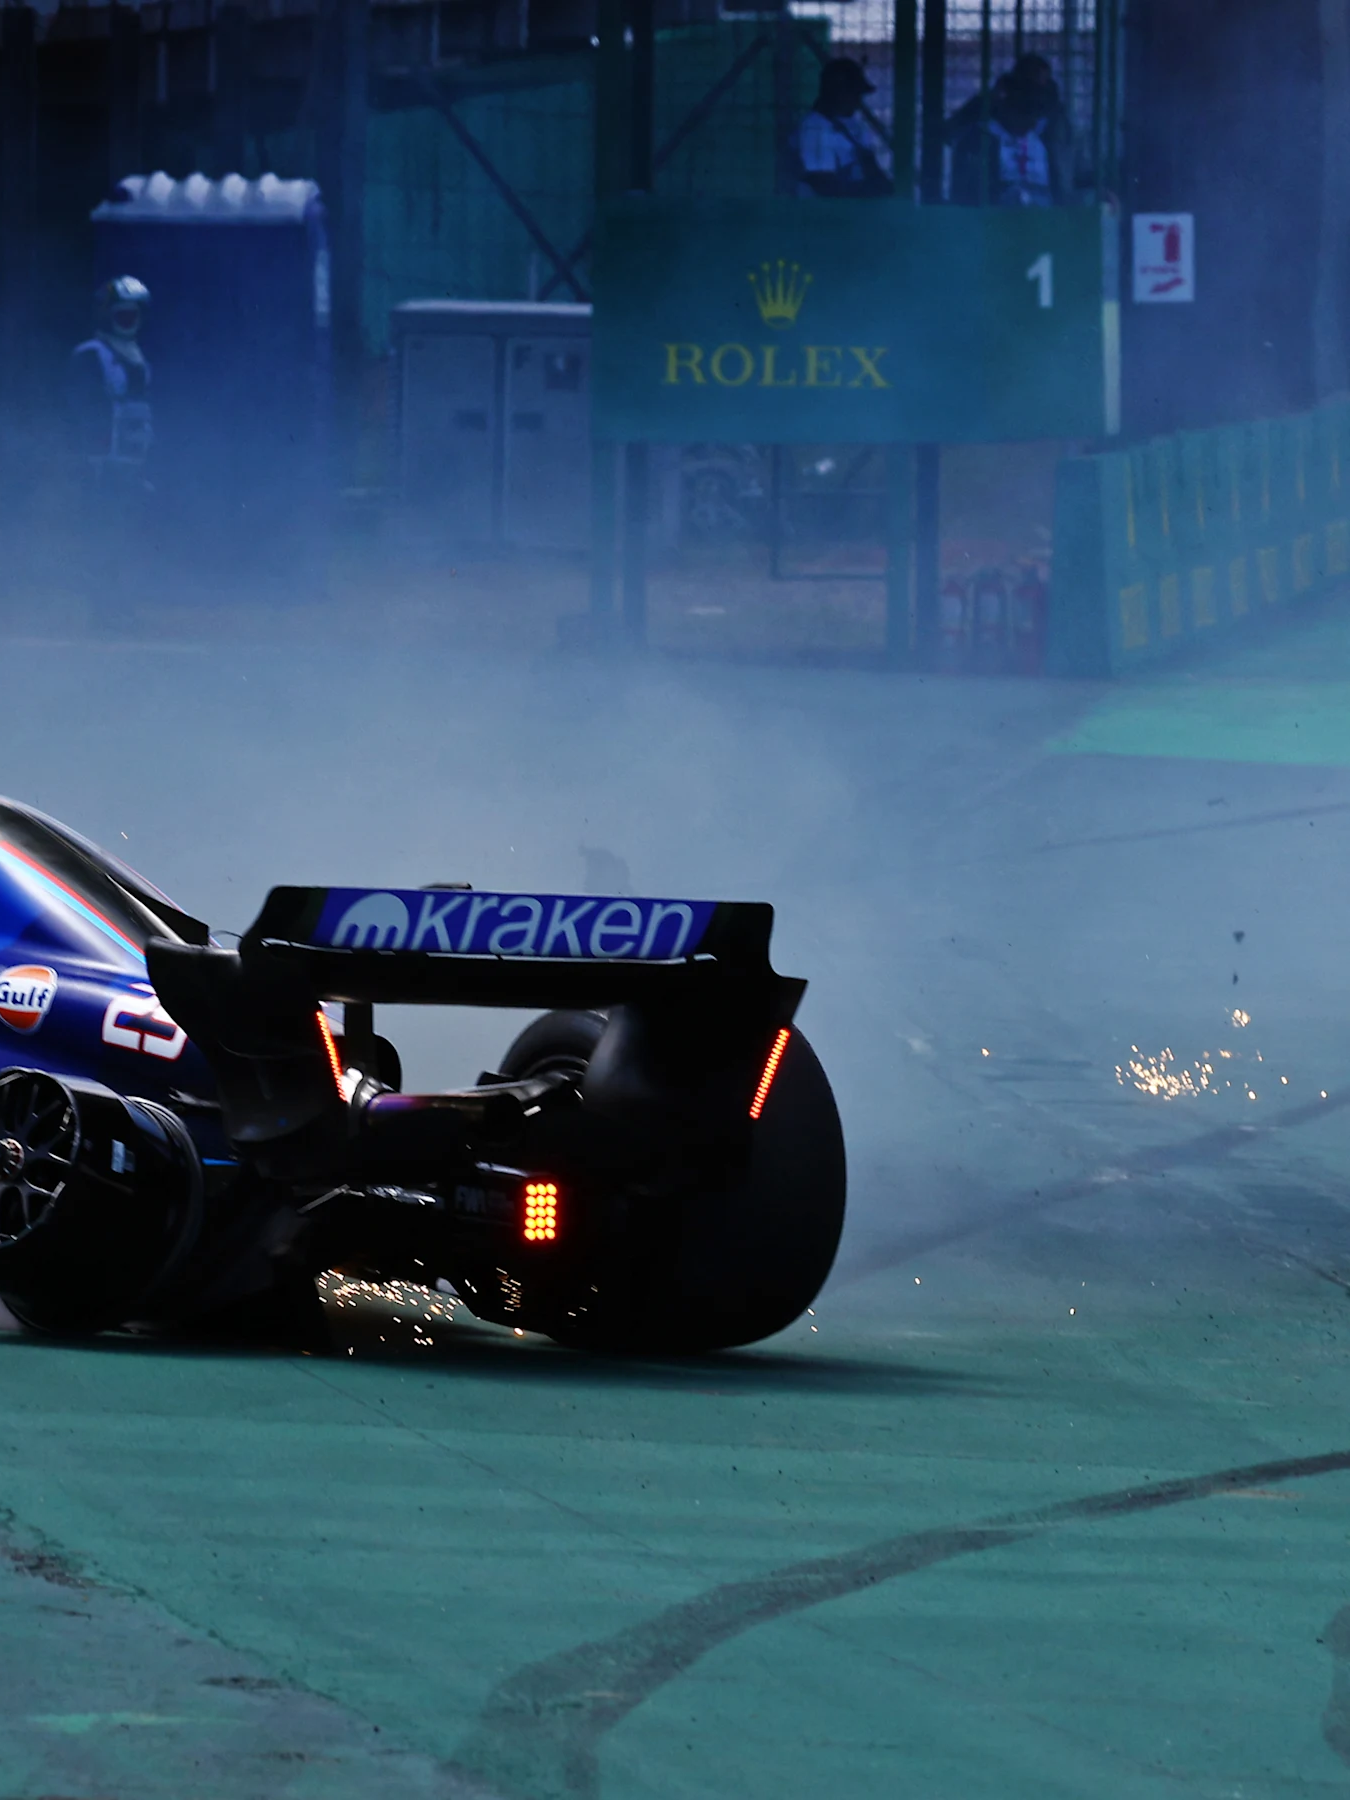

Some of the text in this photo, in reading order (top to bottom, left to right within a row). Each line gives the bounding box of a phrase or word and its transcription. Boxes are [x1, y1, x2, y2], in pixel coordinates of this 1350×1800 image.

[1026, 251, 1053, 308] 1
[661, 342, 892, 388] ROLEX
[409, 894, 694, 959] kraken
